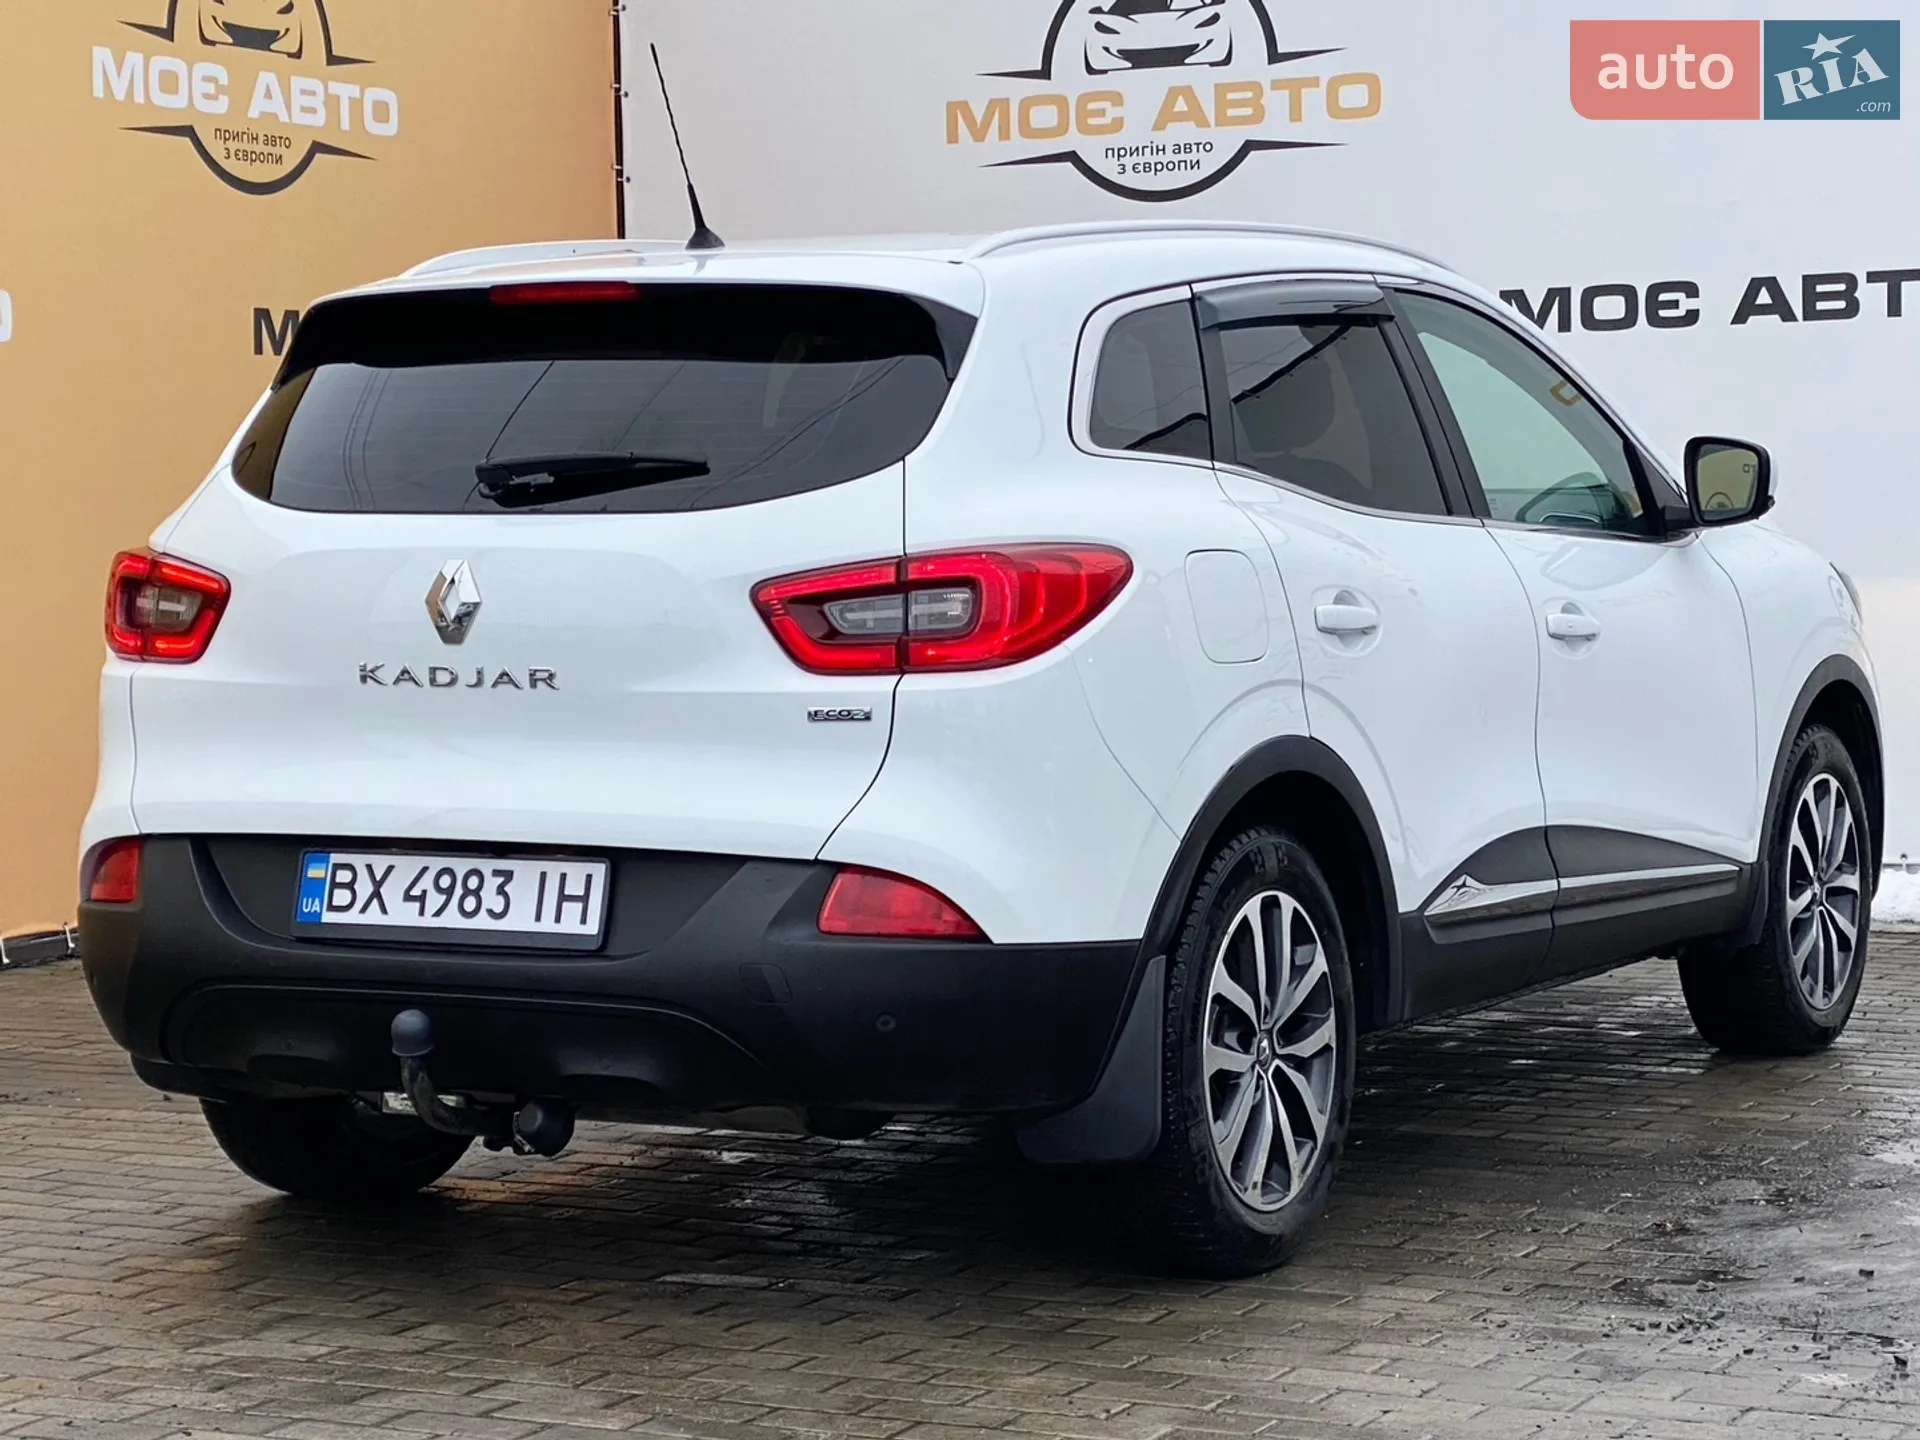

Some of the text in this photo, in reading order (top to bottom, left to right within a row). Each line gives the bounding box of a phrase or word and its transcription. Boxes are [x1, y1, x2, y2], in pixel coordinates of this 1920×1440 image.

[91, 46, 399, 137] МОЄ АВТО
[945, 72, 1382, 145] МОЄ АВТО
[214, 127, 292, 149] пригін авто
[234, 148, 283, 167] європи
[1104, 140, 1214, 162] пригін авто
[1132, 159, 1201, 176] європи
[358, 662, 560, 691] KADJAR
[402, 865, 515, 920] 4983
[302, 897, 320, 914] UA
